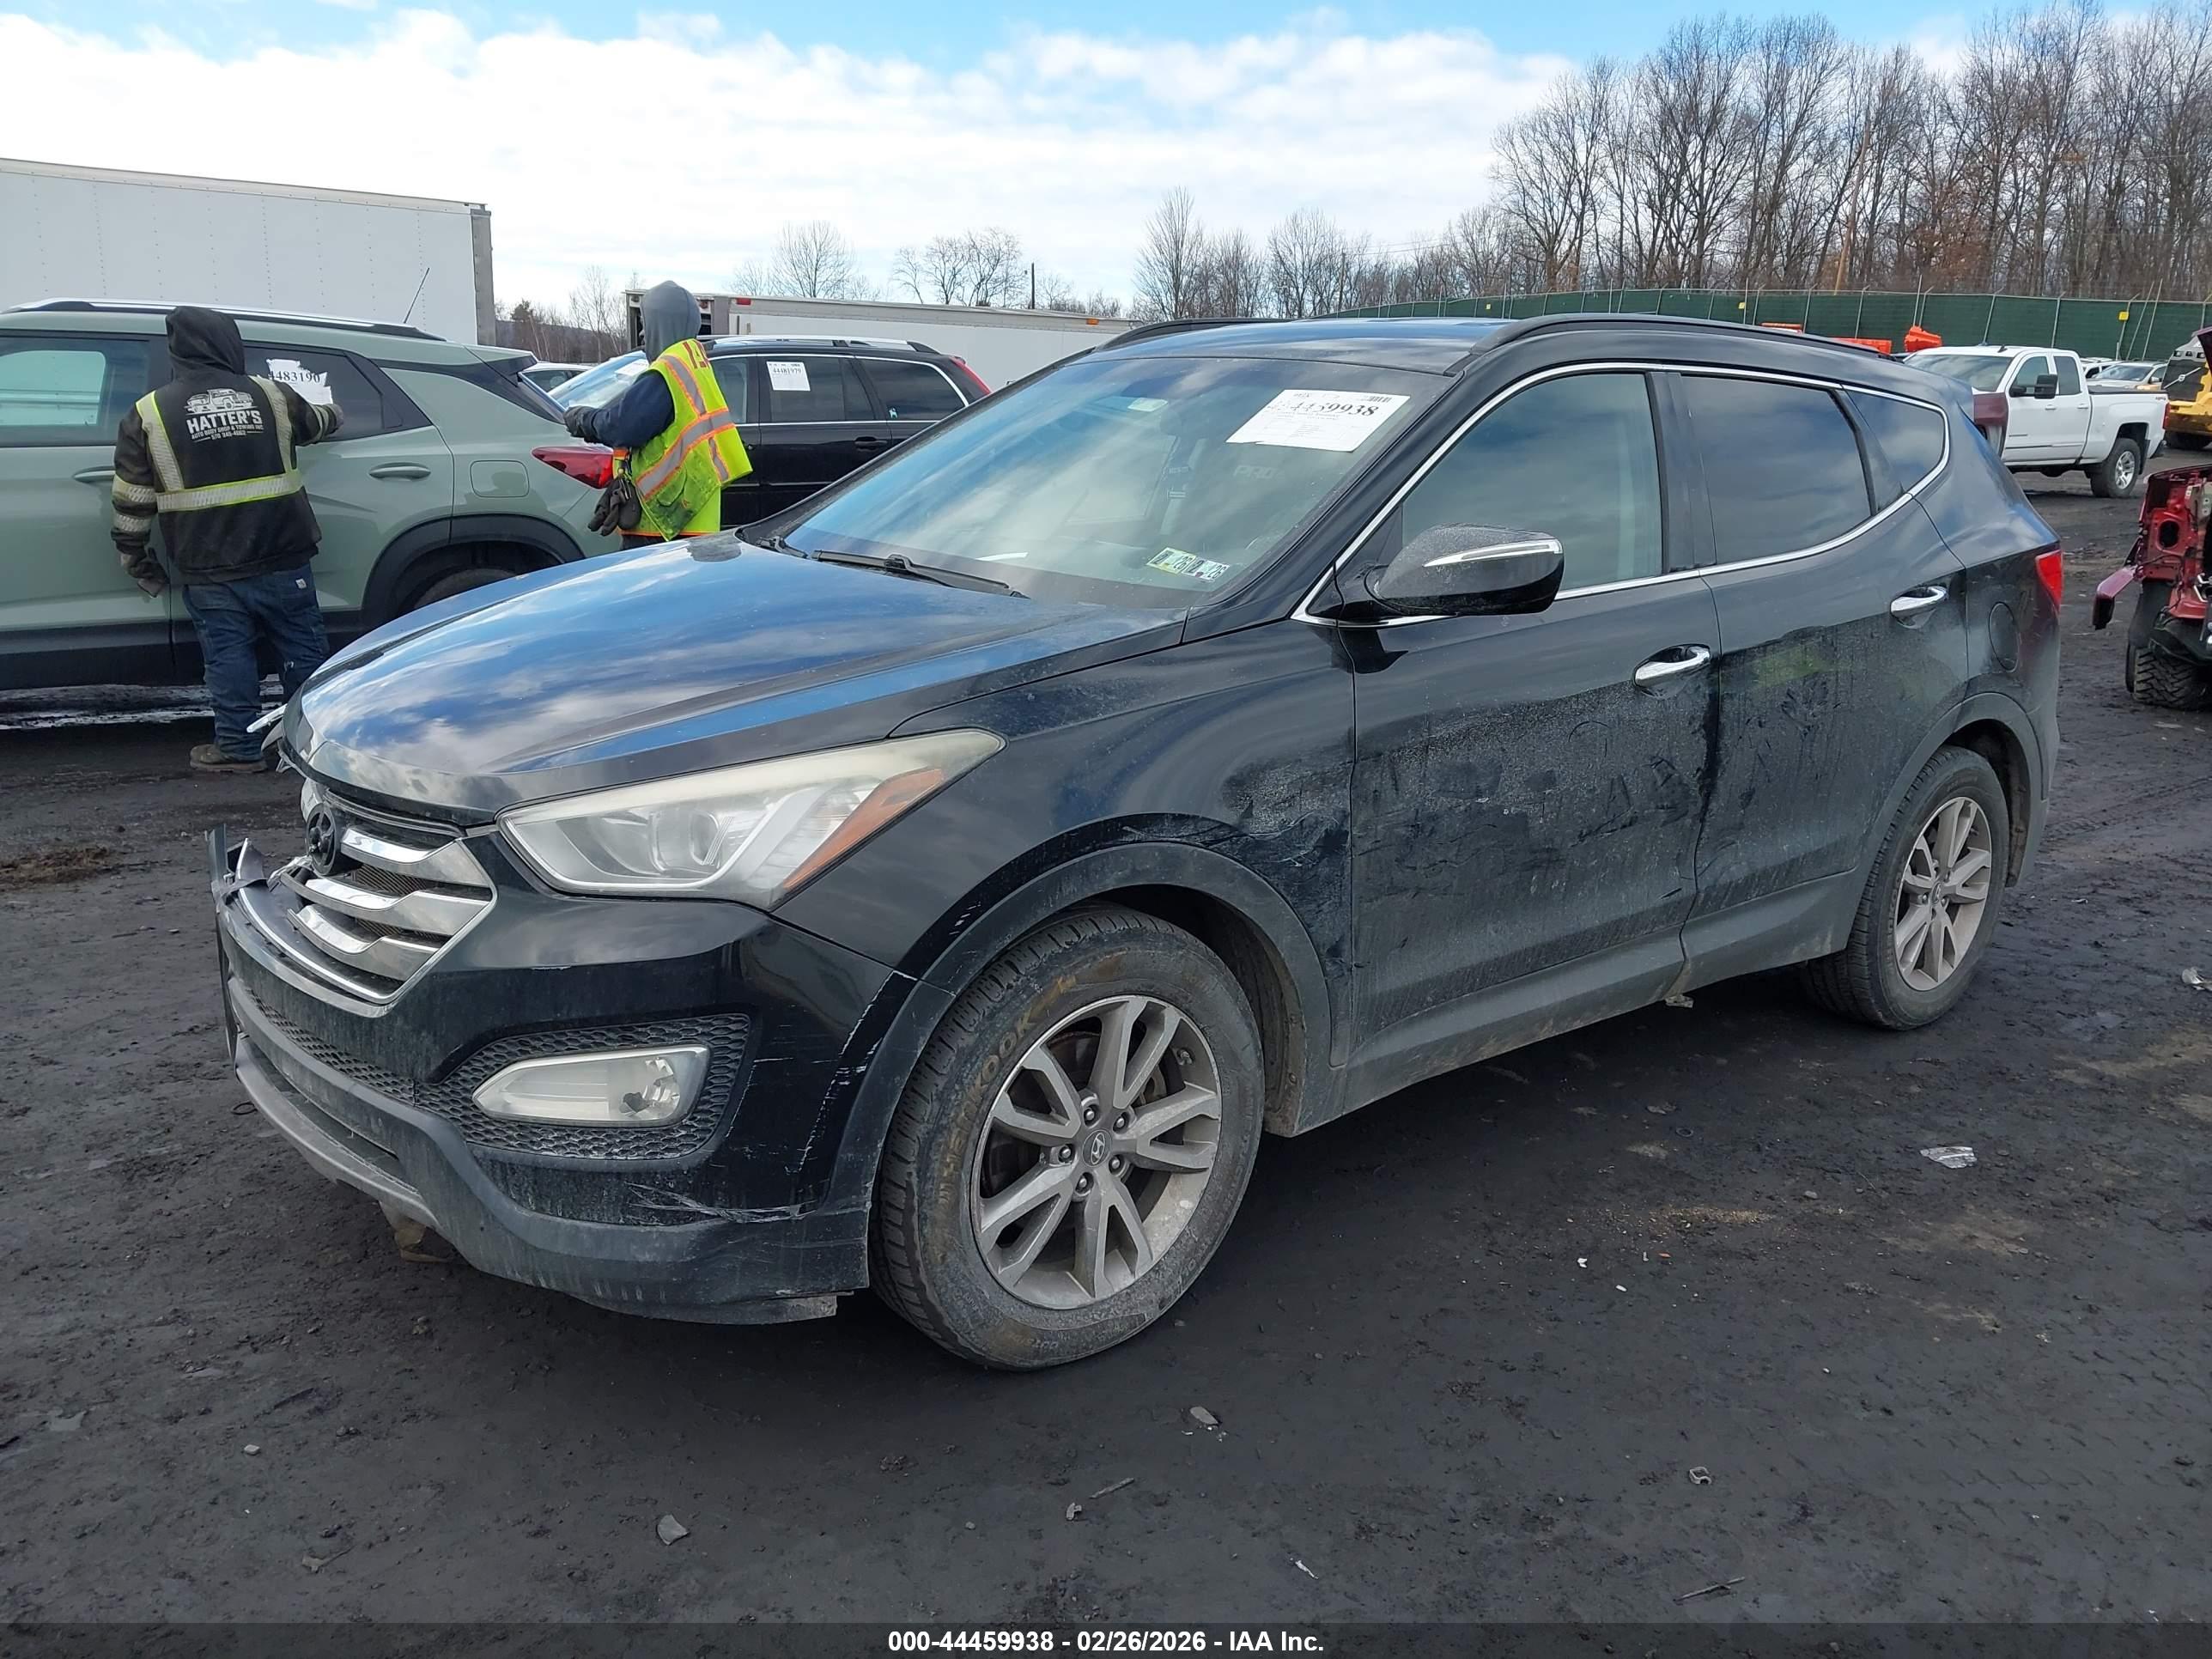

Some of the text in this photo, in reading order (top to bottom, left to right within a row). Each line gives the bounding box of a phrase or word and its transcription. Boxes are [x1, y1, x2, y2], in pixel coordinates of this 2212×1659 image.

[186, 410, 263, 434] HATTER'S
[191, 431, 204, 440] AUTO
[204, 428, 217, 436] BODY
[1188, 559, 1206, 574] 2
